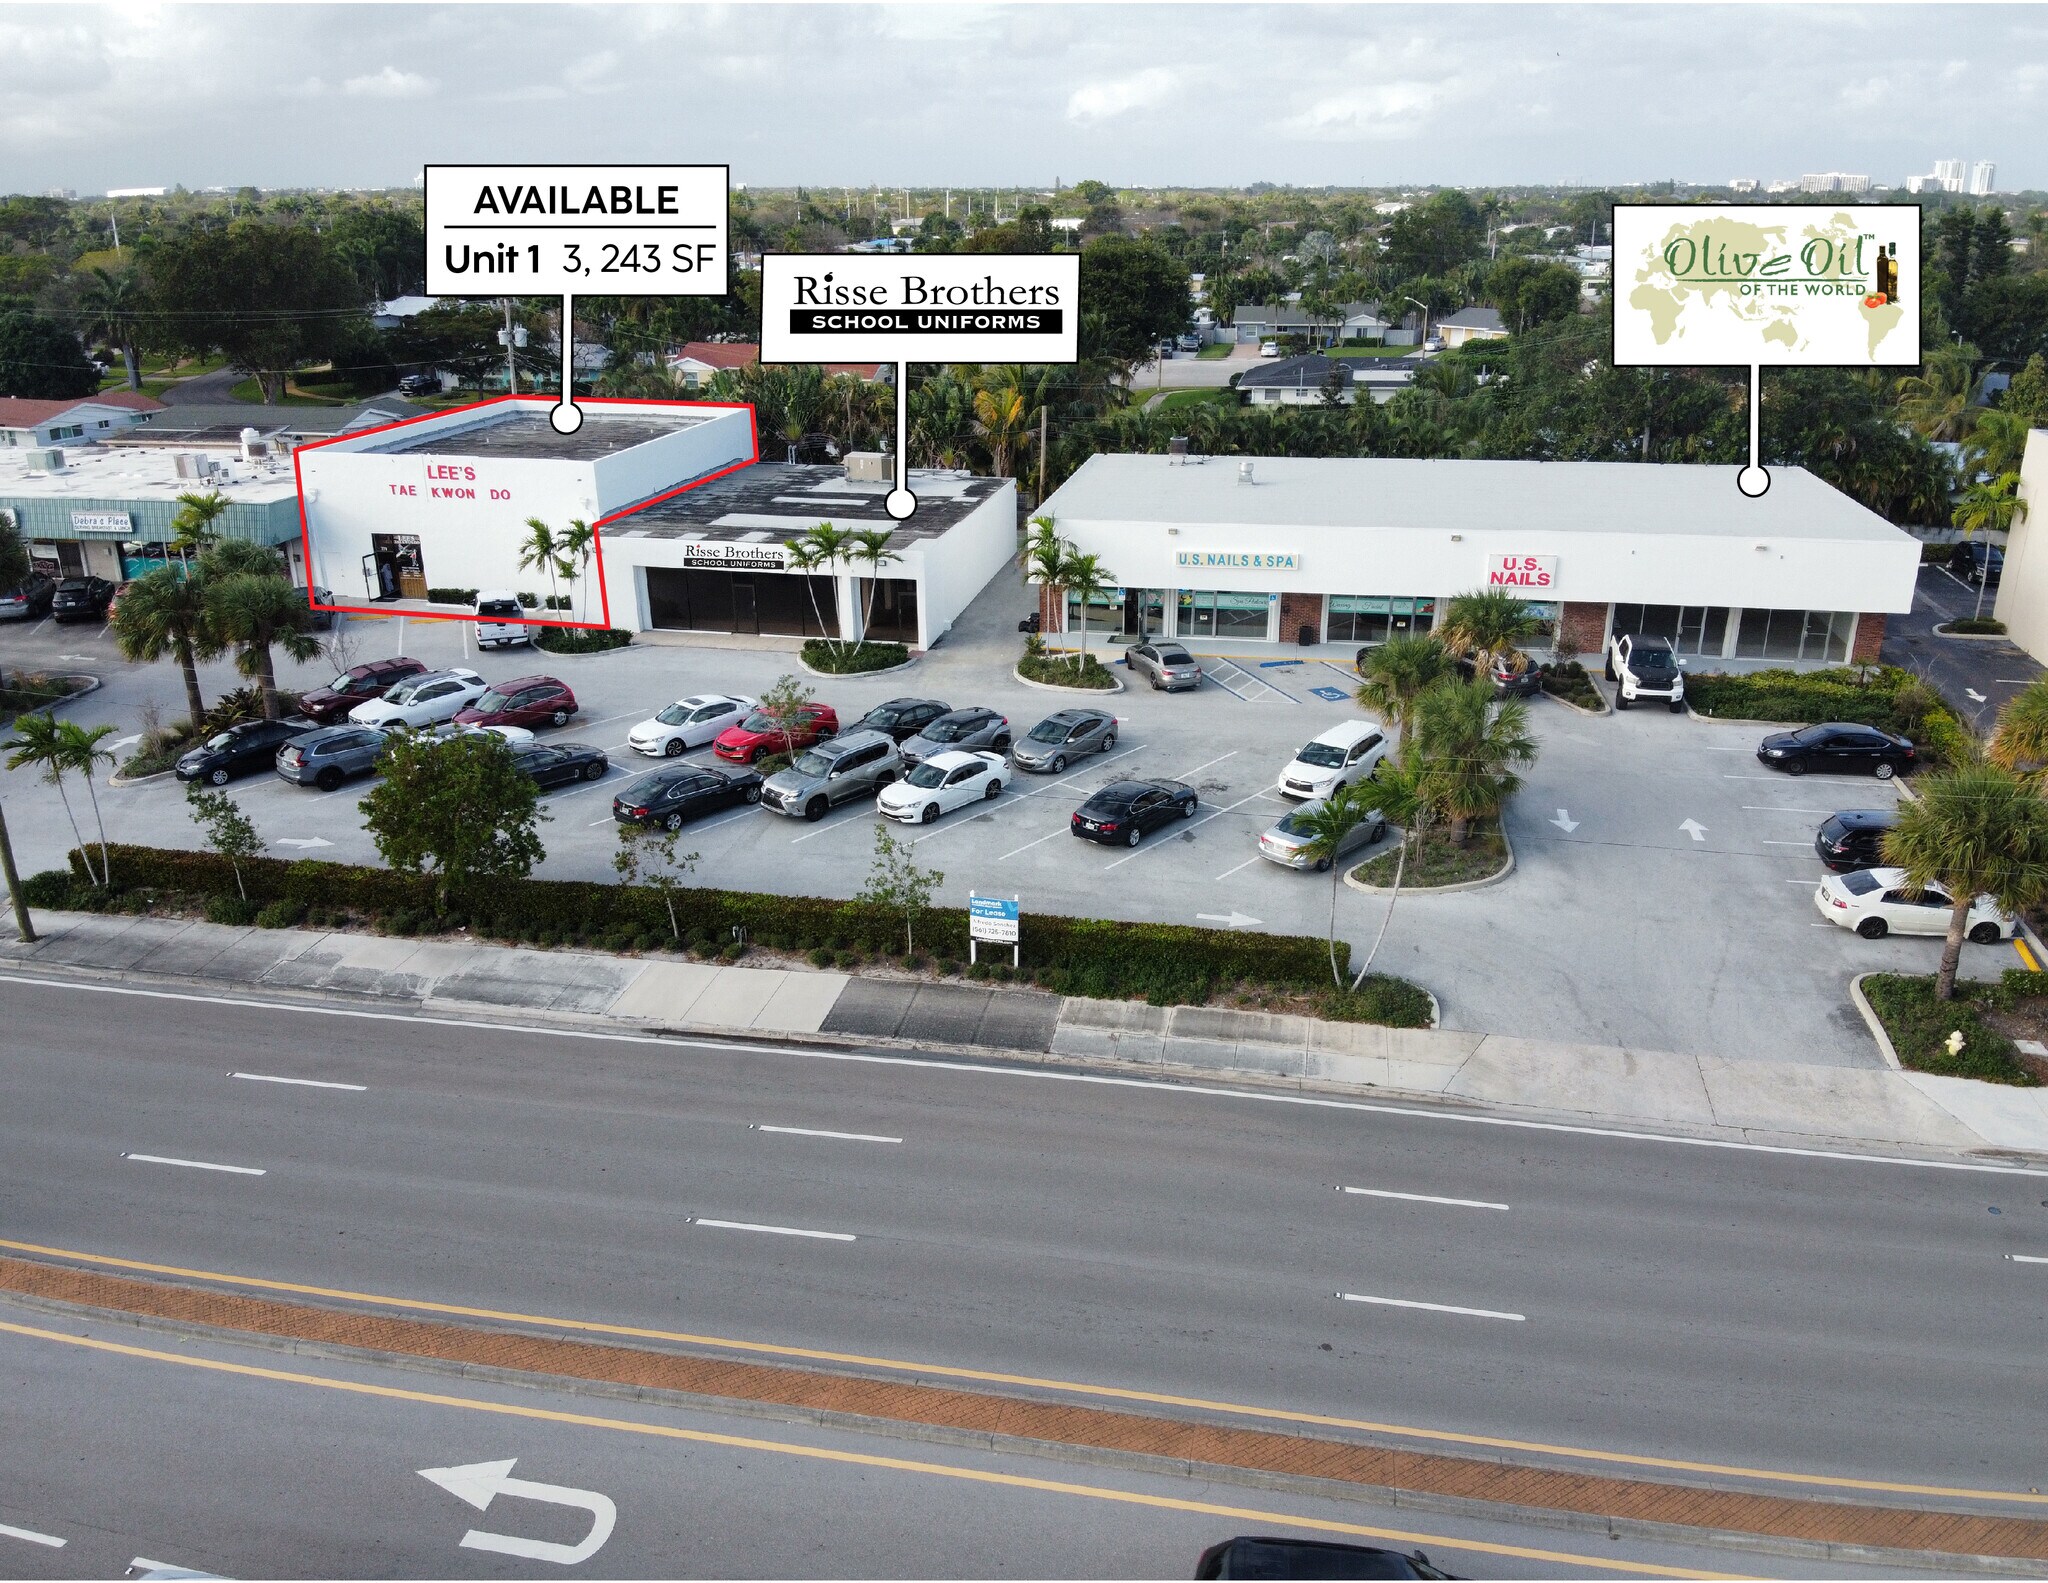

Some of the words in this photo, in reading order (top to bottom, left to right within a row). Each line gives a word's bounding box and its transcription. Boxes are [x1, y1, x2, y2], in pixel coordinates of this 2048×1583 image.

[427, 465, 477, 481] LEE'S
[389, 484, 417, 496] TAE
[431, 487, 476, 499] KWON
[490, 488, 512, 500] DO
[108, 517, 129, 525] Place
[685, 544, 721, 557] Risse
[725, 546, 784, 559] Brothers
[691, 559, 728, 567] SCHOOL
[730, 560, 776, 568] UNIFORMS
[1179, 553, 1204, 566] U.S.
[1207, 554, 1250, 567] NAILS
[1253, 555, 1262, 567] &
[1266, 556, 1294, 568] SPA
[1503, 557, 1543, 571] U.S.
[1490, 572, 1551, 586] NAILS
[984, 909, 1006, 917] Lease
